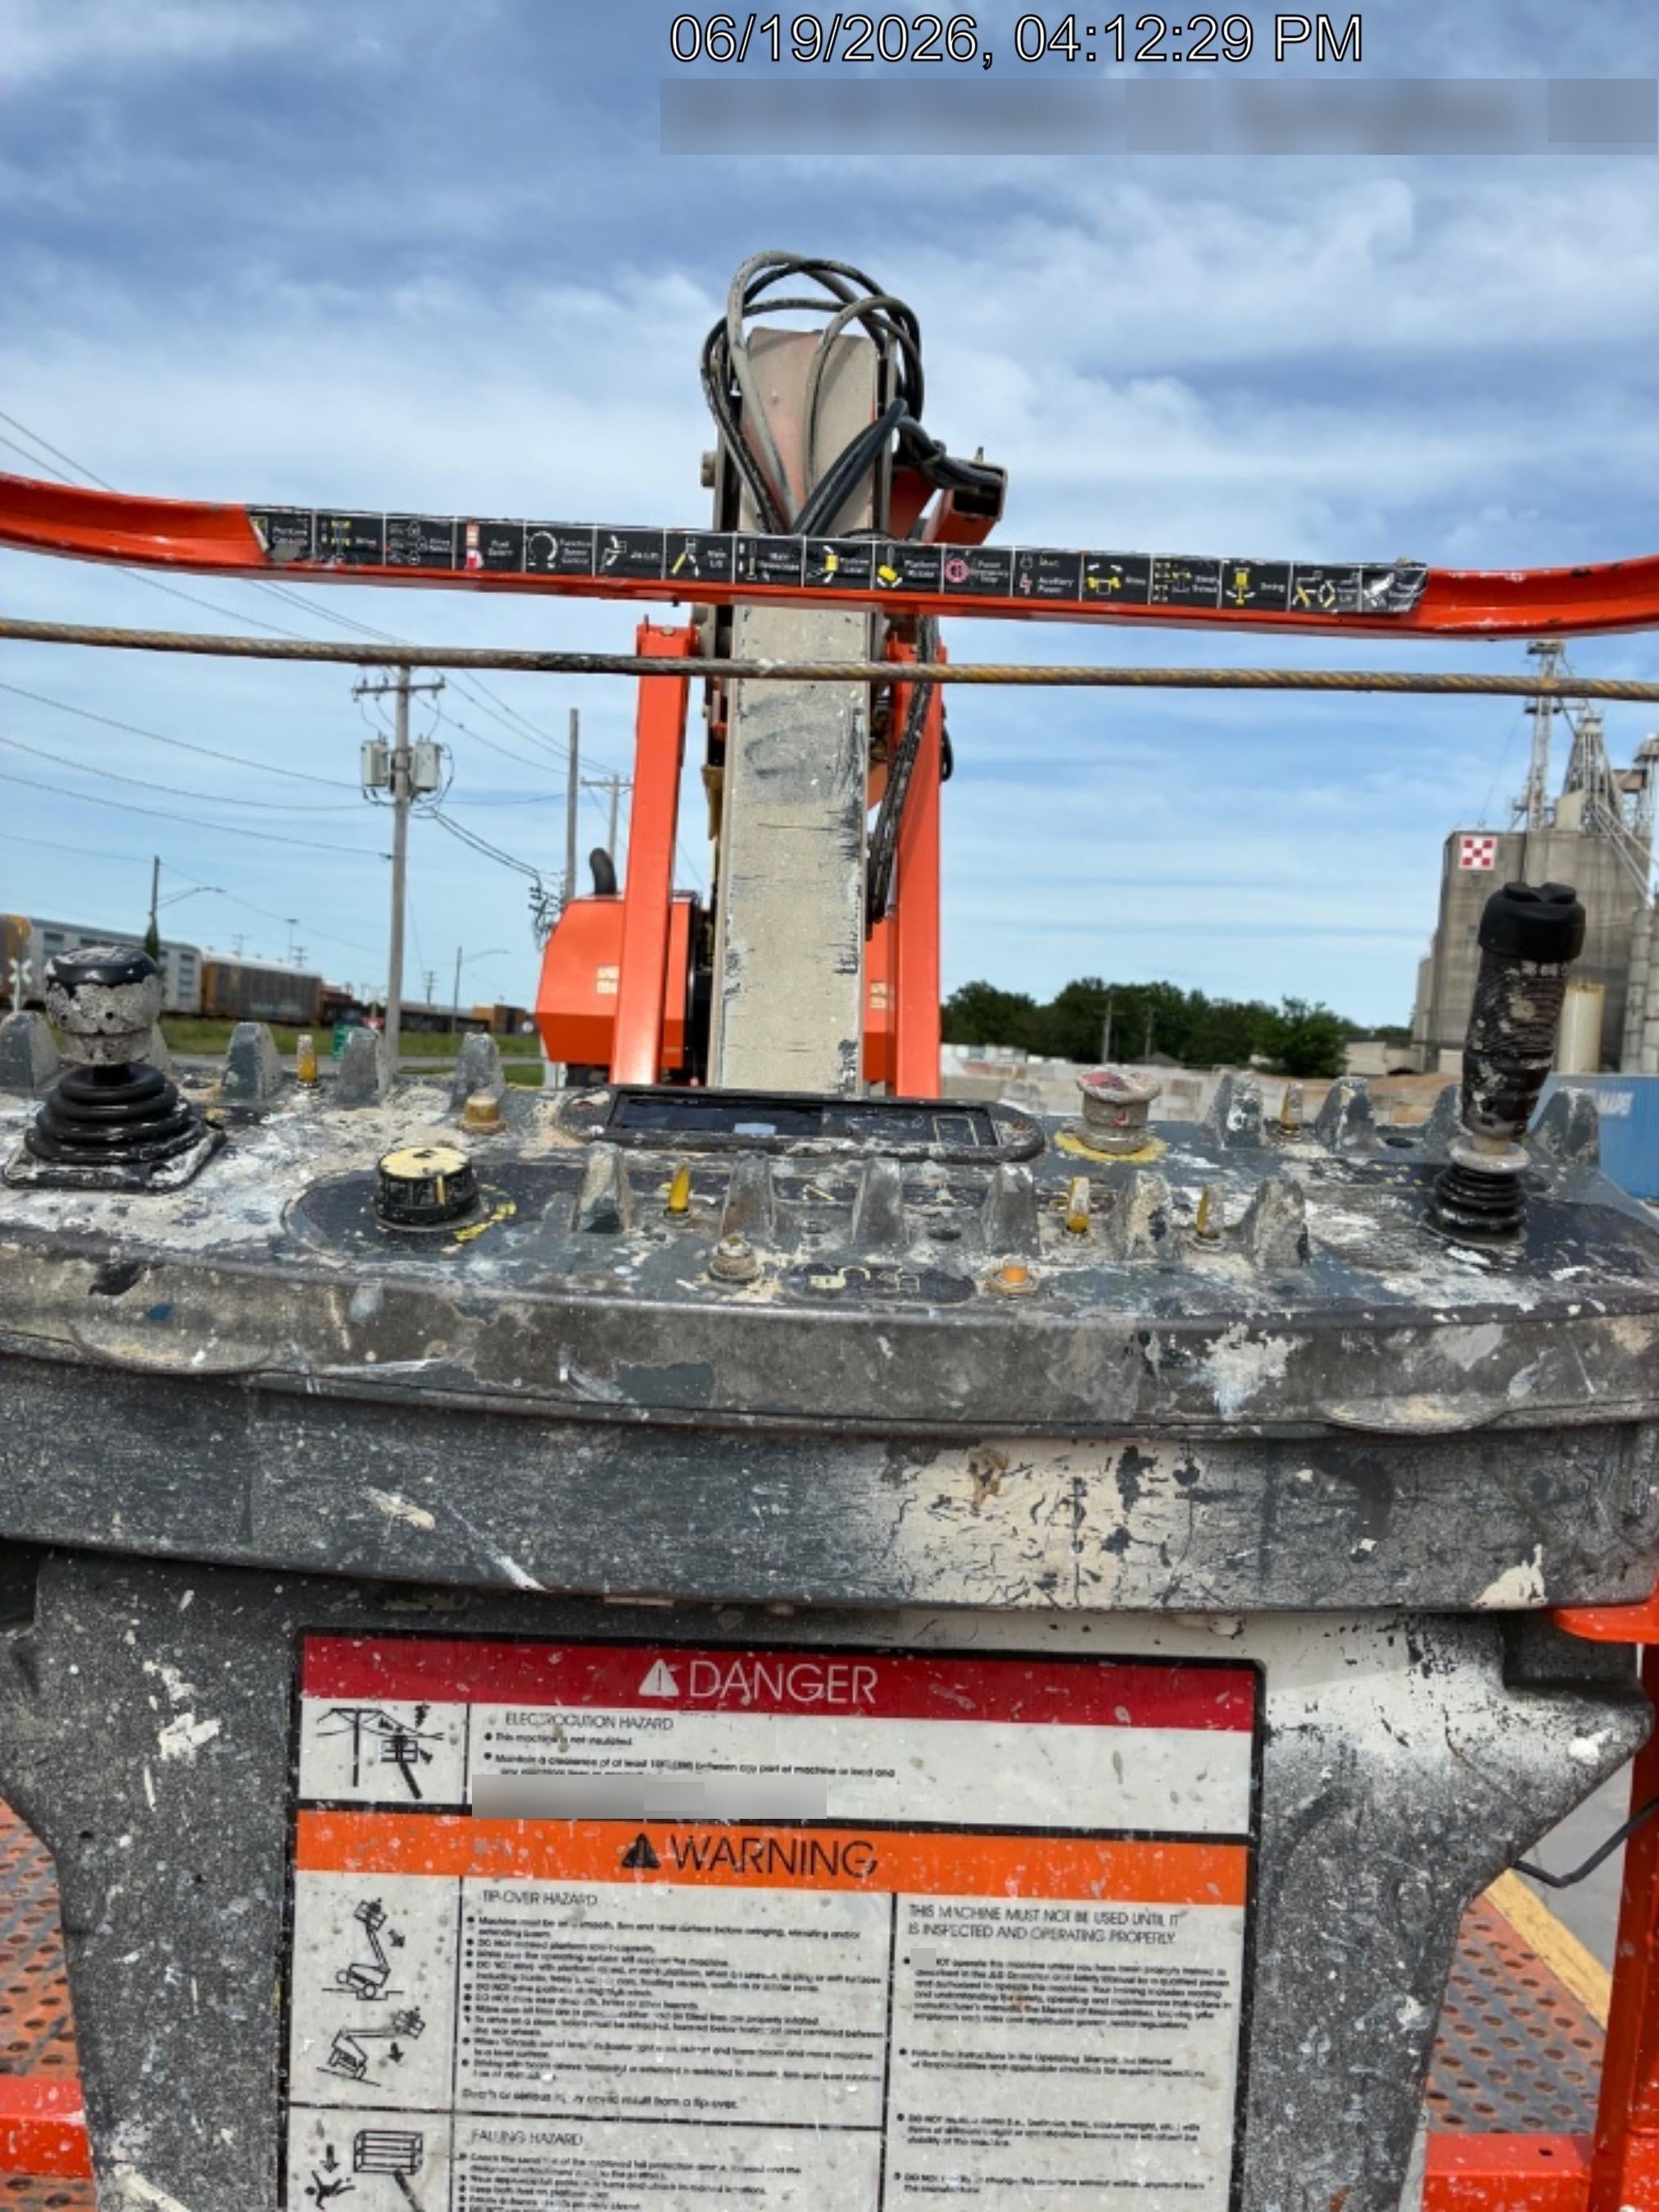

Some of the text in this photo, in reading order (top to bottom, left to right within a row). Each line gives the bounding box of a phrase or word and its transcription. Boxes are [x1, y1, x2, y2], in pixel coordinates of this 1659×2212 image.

[688, 1659, 878, 1704] DANGER
[505, 1711, 673, 1729] ELECTROCUTION HAZARD
[496, 1733, 514, 1742] This
[669, 1834, 877, 1878] WARNING
[542, 1891, 597, 1906] HAZARD
[909, 1903, 1178, 1927] THIS MACHINE MUST NOT BE USED UNTIL IT
[909, 1921, 919, 1934] IS
[923, 1922, 992, 1938] INSPECTED
[997, 1925, 1027, 1939] AND
[1030, 1927, 1105, 1942] OPERATING
